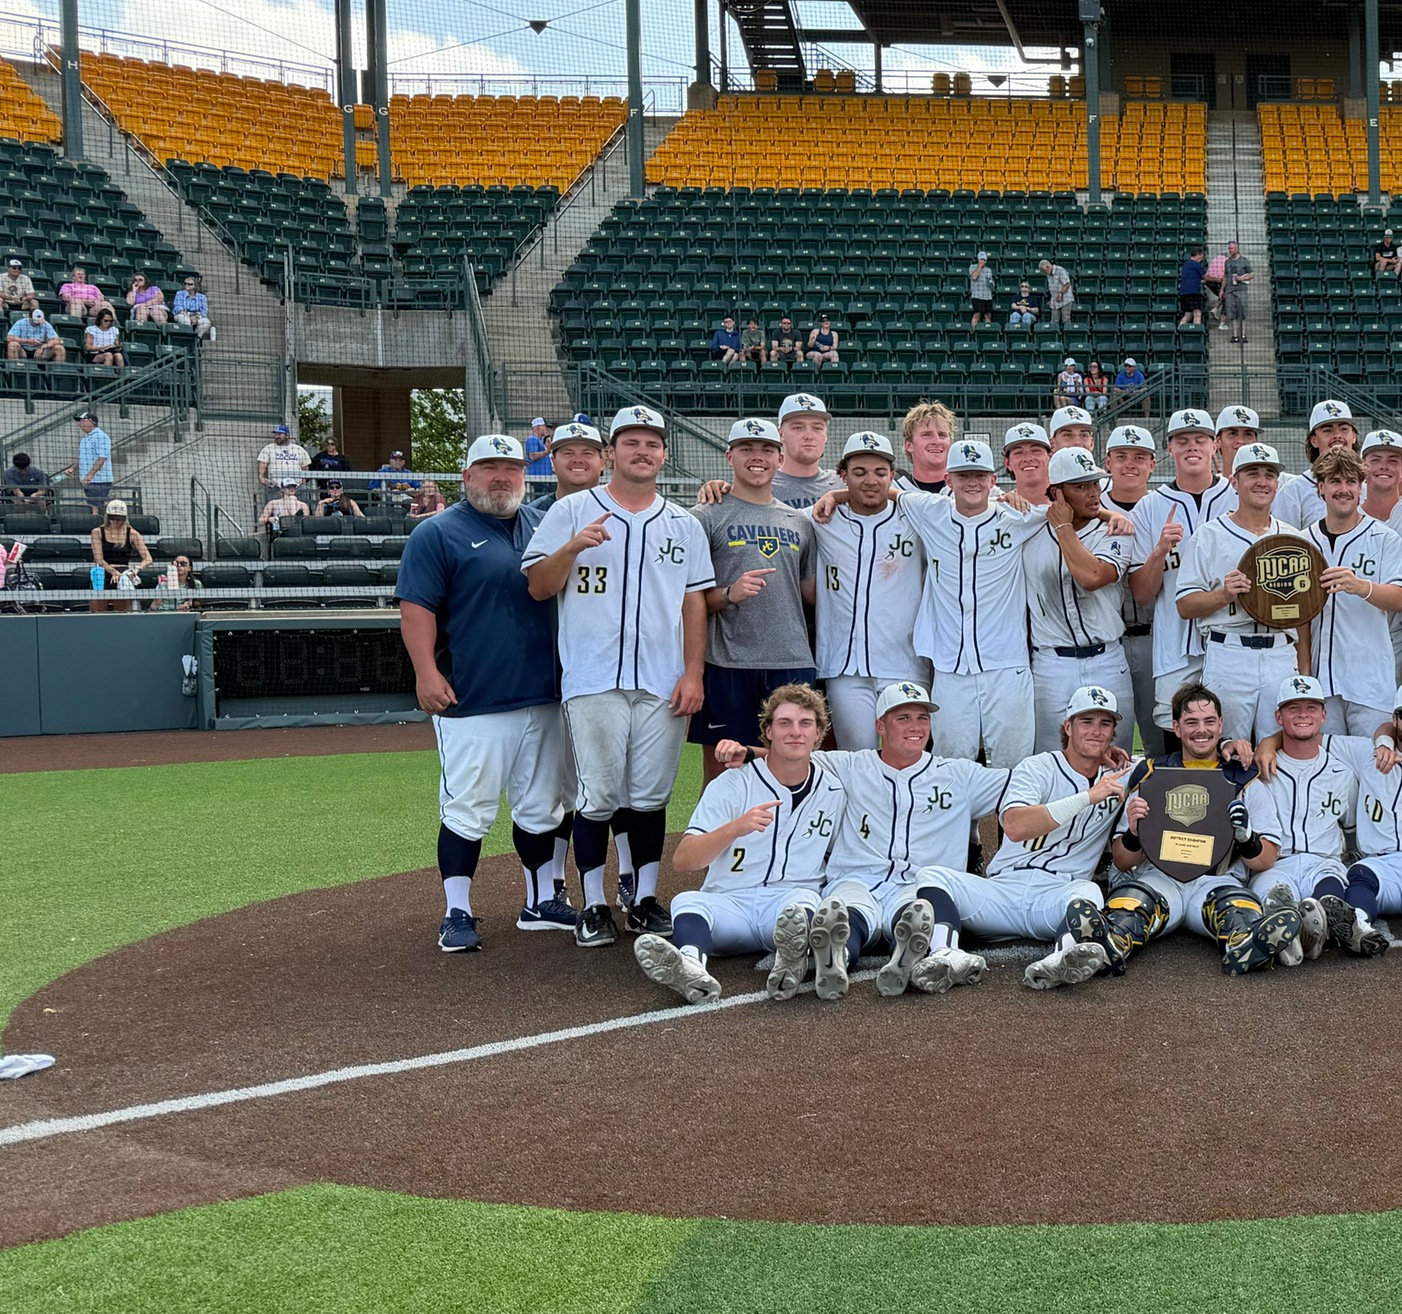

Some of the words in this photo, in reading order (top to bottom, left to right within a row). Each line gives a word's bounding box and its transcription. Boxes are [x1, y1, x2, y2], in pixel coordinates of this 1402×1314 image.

[67, 60, 78, 70] H
[344, 104, 354, 113] G
[379, 106, 388, 116] G
[630, 108, 639, 118] F
[1089, 114, 1098, 124] F
[1370, 118, 1378, 128] E
[727, 525, 801, 546] CAVALIERS
[889, 534, 914, 558] JC
[990, 528, 1013, 549] JC
[659, 537, 685, 564] JC
[1258, 555, 1310, 583] NJCAA
[1351, 553, 1376, 577] JC
[577, 565, 607, 595] 33
[826, 564, 840, 592] 13
[1299, 579, 1306, 589] 6
[928, 786, 953, 810] JC
[1167, 792, 1208, 812] NJCAA
[1321, 791, 1342, 816] JC
[810, 810, 833, 838] JC
[730, 847, 746, 872] 2
